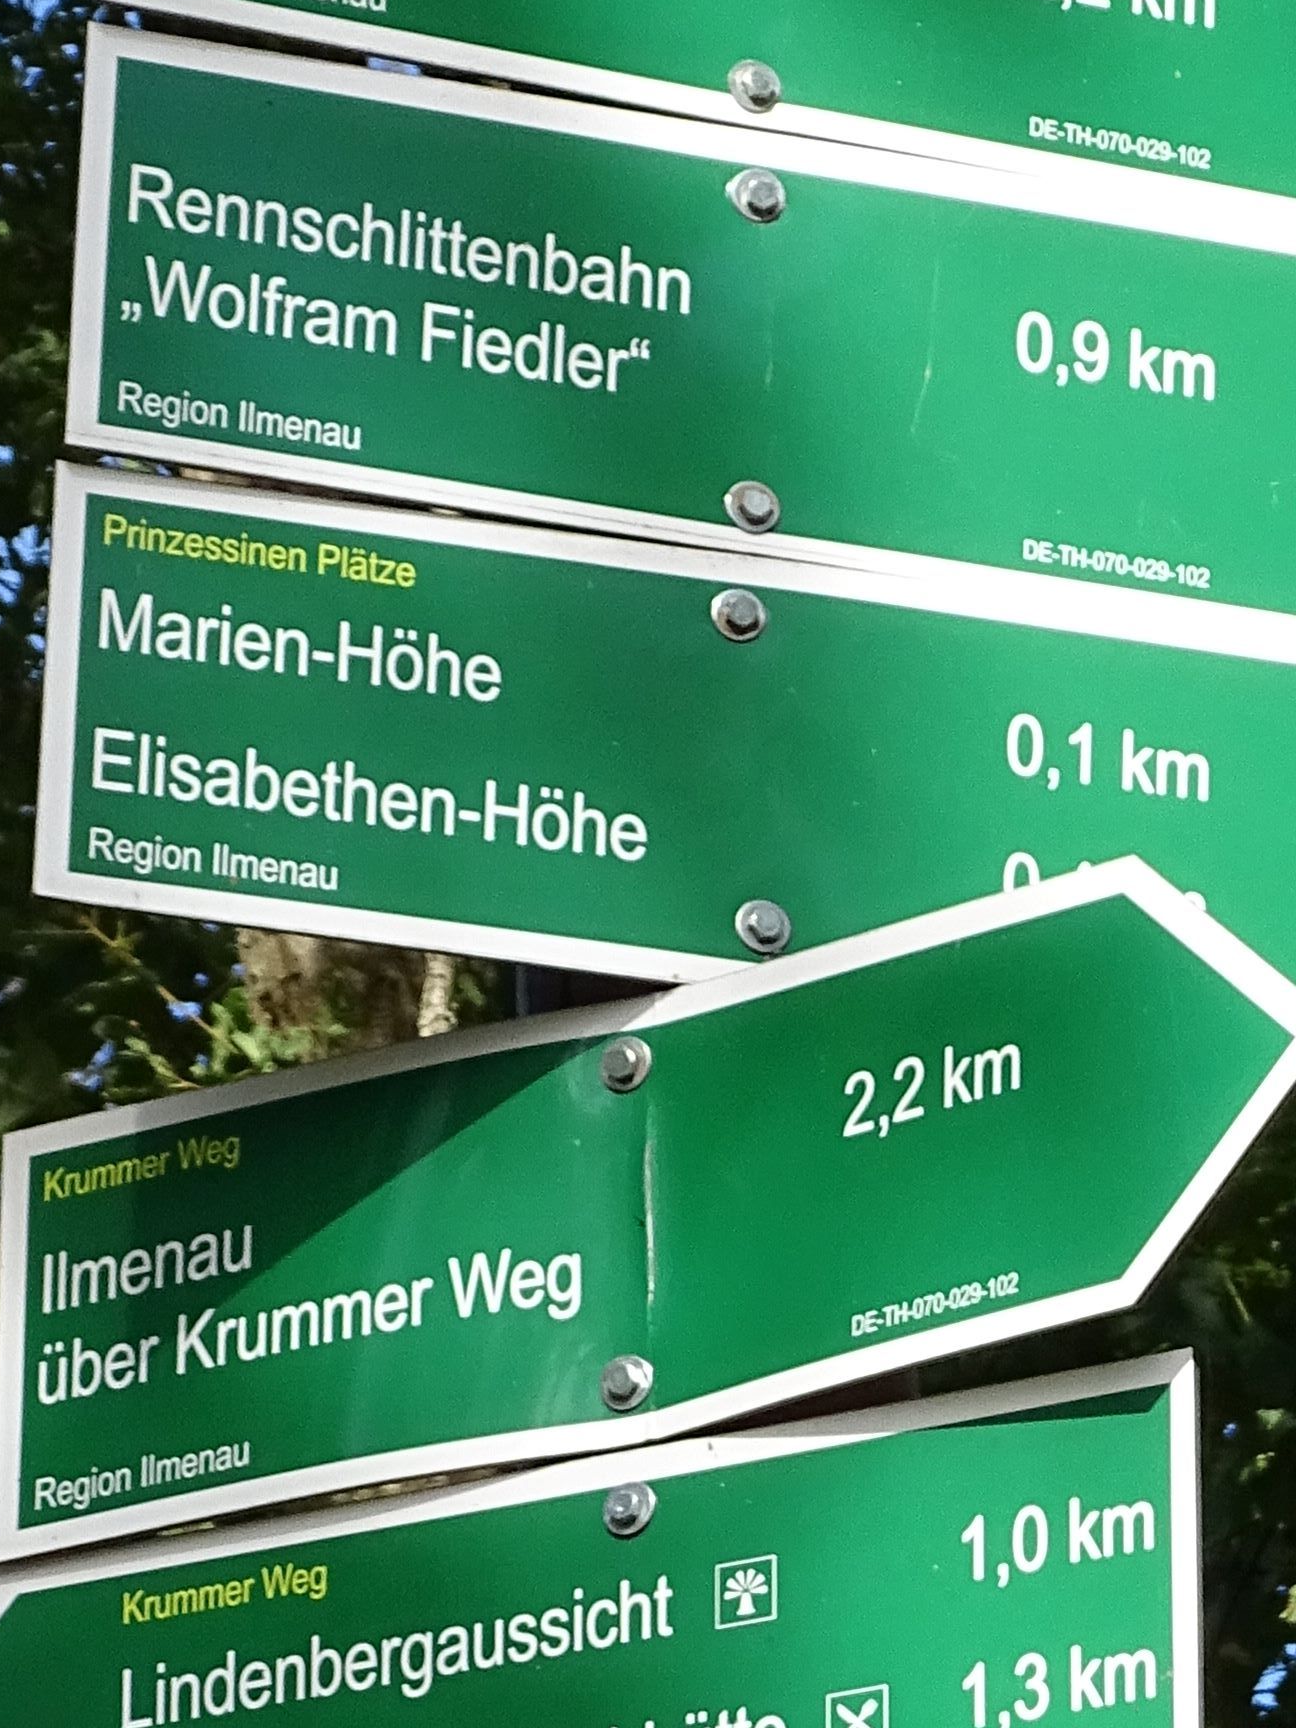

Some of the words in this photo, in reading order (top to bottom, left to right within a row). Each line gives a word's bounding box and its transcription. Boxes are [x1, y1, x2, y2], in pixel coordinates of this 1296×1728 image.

[1029, 116, 1211, 169] DE-TH-070-029-102
[128, 163, 691, 314] Rennschlittenbahn
[1017, 311, 1109, 385] 0,9
[1130, 328, 1215, 400] km
[118, 381, 228, 428] Region
[239, 401, 361, 450] Ilmenau
[104, 514, 306, 572] Prinzessinen
[318, 544, 416, 587] Plätze
[1023, 539, 1210, 588] DE-TH-070-029-102
[99, 588, 501, 701] Marien-Höhe
[1007, 714, 1092, 789] 0,1
[1122, 729, 1209, 801] km
[92, 727, 648, 862] Elisabethen-Höhe
[89, 827, 201, 874] Region
[213, 843, 338, 890] Ilmenau
[843, 1057, 924, 1137] 2,2
[944, 1045, 1020, 1108] km
[44, 1152, 169, 1201] Krummer
[178, 1136, 240, 1169] Weg
[42, 1225, 252, 1314] Ilmenau
[852, 1272, 1018, 1336] DE-TH-070-029-102
[38, 1336, 159, 1404] über
[177, 1278, 433, 1374] Krummer
[449, 1248, 581, 1319] Weg
[34, 1467, 131, 1510] Region
[141, 1442, 249, 1487] Ilmenau
[962, 1505, 1048, 1587] 1,0
[1069, 1497, 1154, 1563] km
[123, 1578, 255, 1624] Krummer
[262, 1563, 327, 1599] Weg
[1071, 1645, 1156, 1711] km
